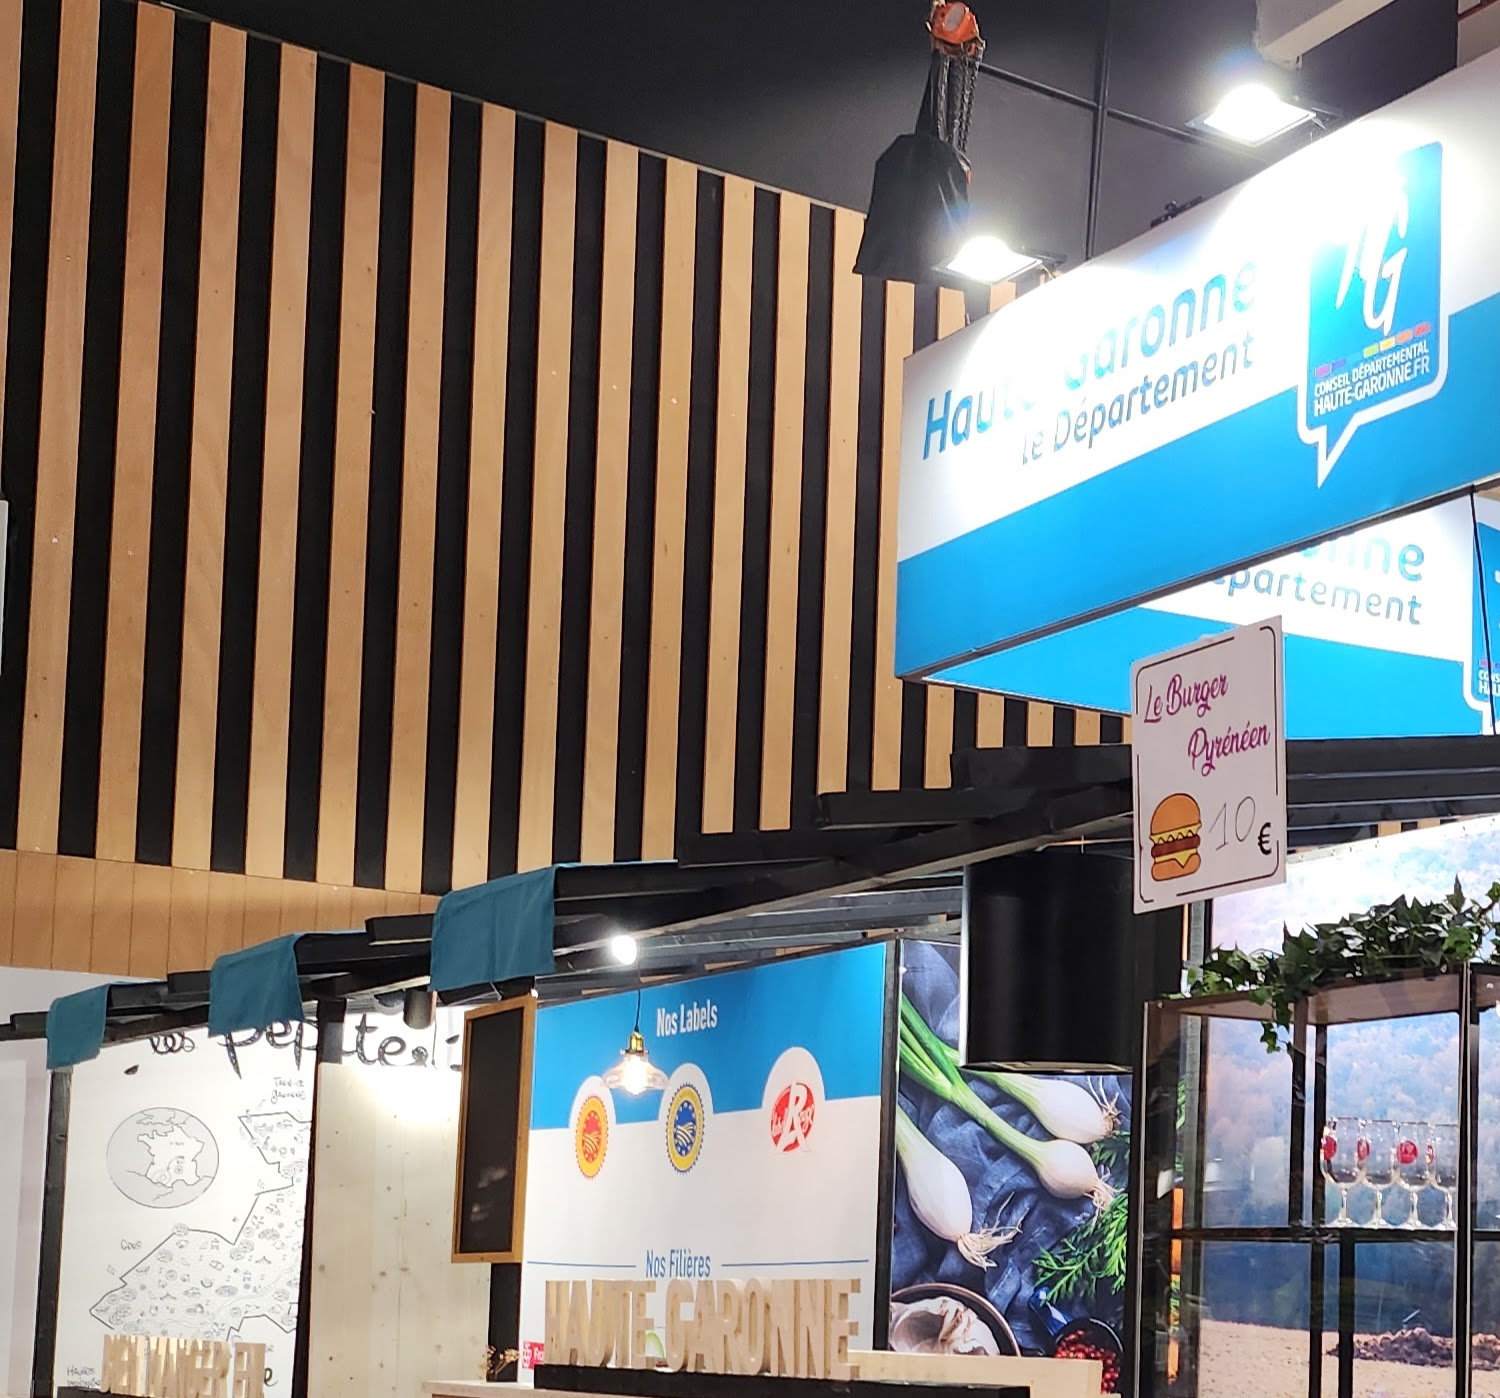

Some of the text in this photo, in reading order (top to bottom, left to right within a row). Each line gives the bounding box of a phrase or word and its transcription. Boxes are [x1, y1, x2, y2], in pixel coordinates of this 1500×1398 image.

[1053, 330, 1256, 450] Département
[1313, 354, 1431, 417] HAUTE-GARONNE.FR
[1314, 340, 1430, 398] CONSEIL DÉPARTEMENTAL
[1144, 673, 1229, 724] Le Burger
[1187, 720, 1271, 777] Pyrénéen
[1209, 795, 1272, 855] 10 €
[656, 999, 718, 1037] Nos Labels
[646, 1248, 711, 1278] Nos Filières
[545, 1278, 862, 1380] HAUTE GARONNE
